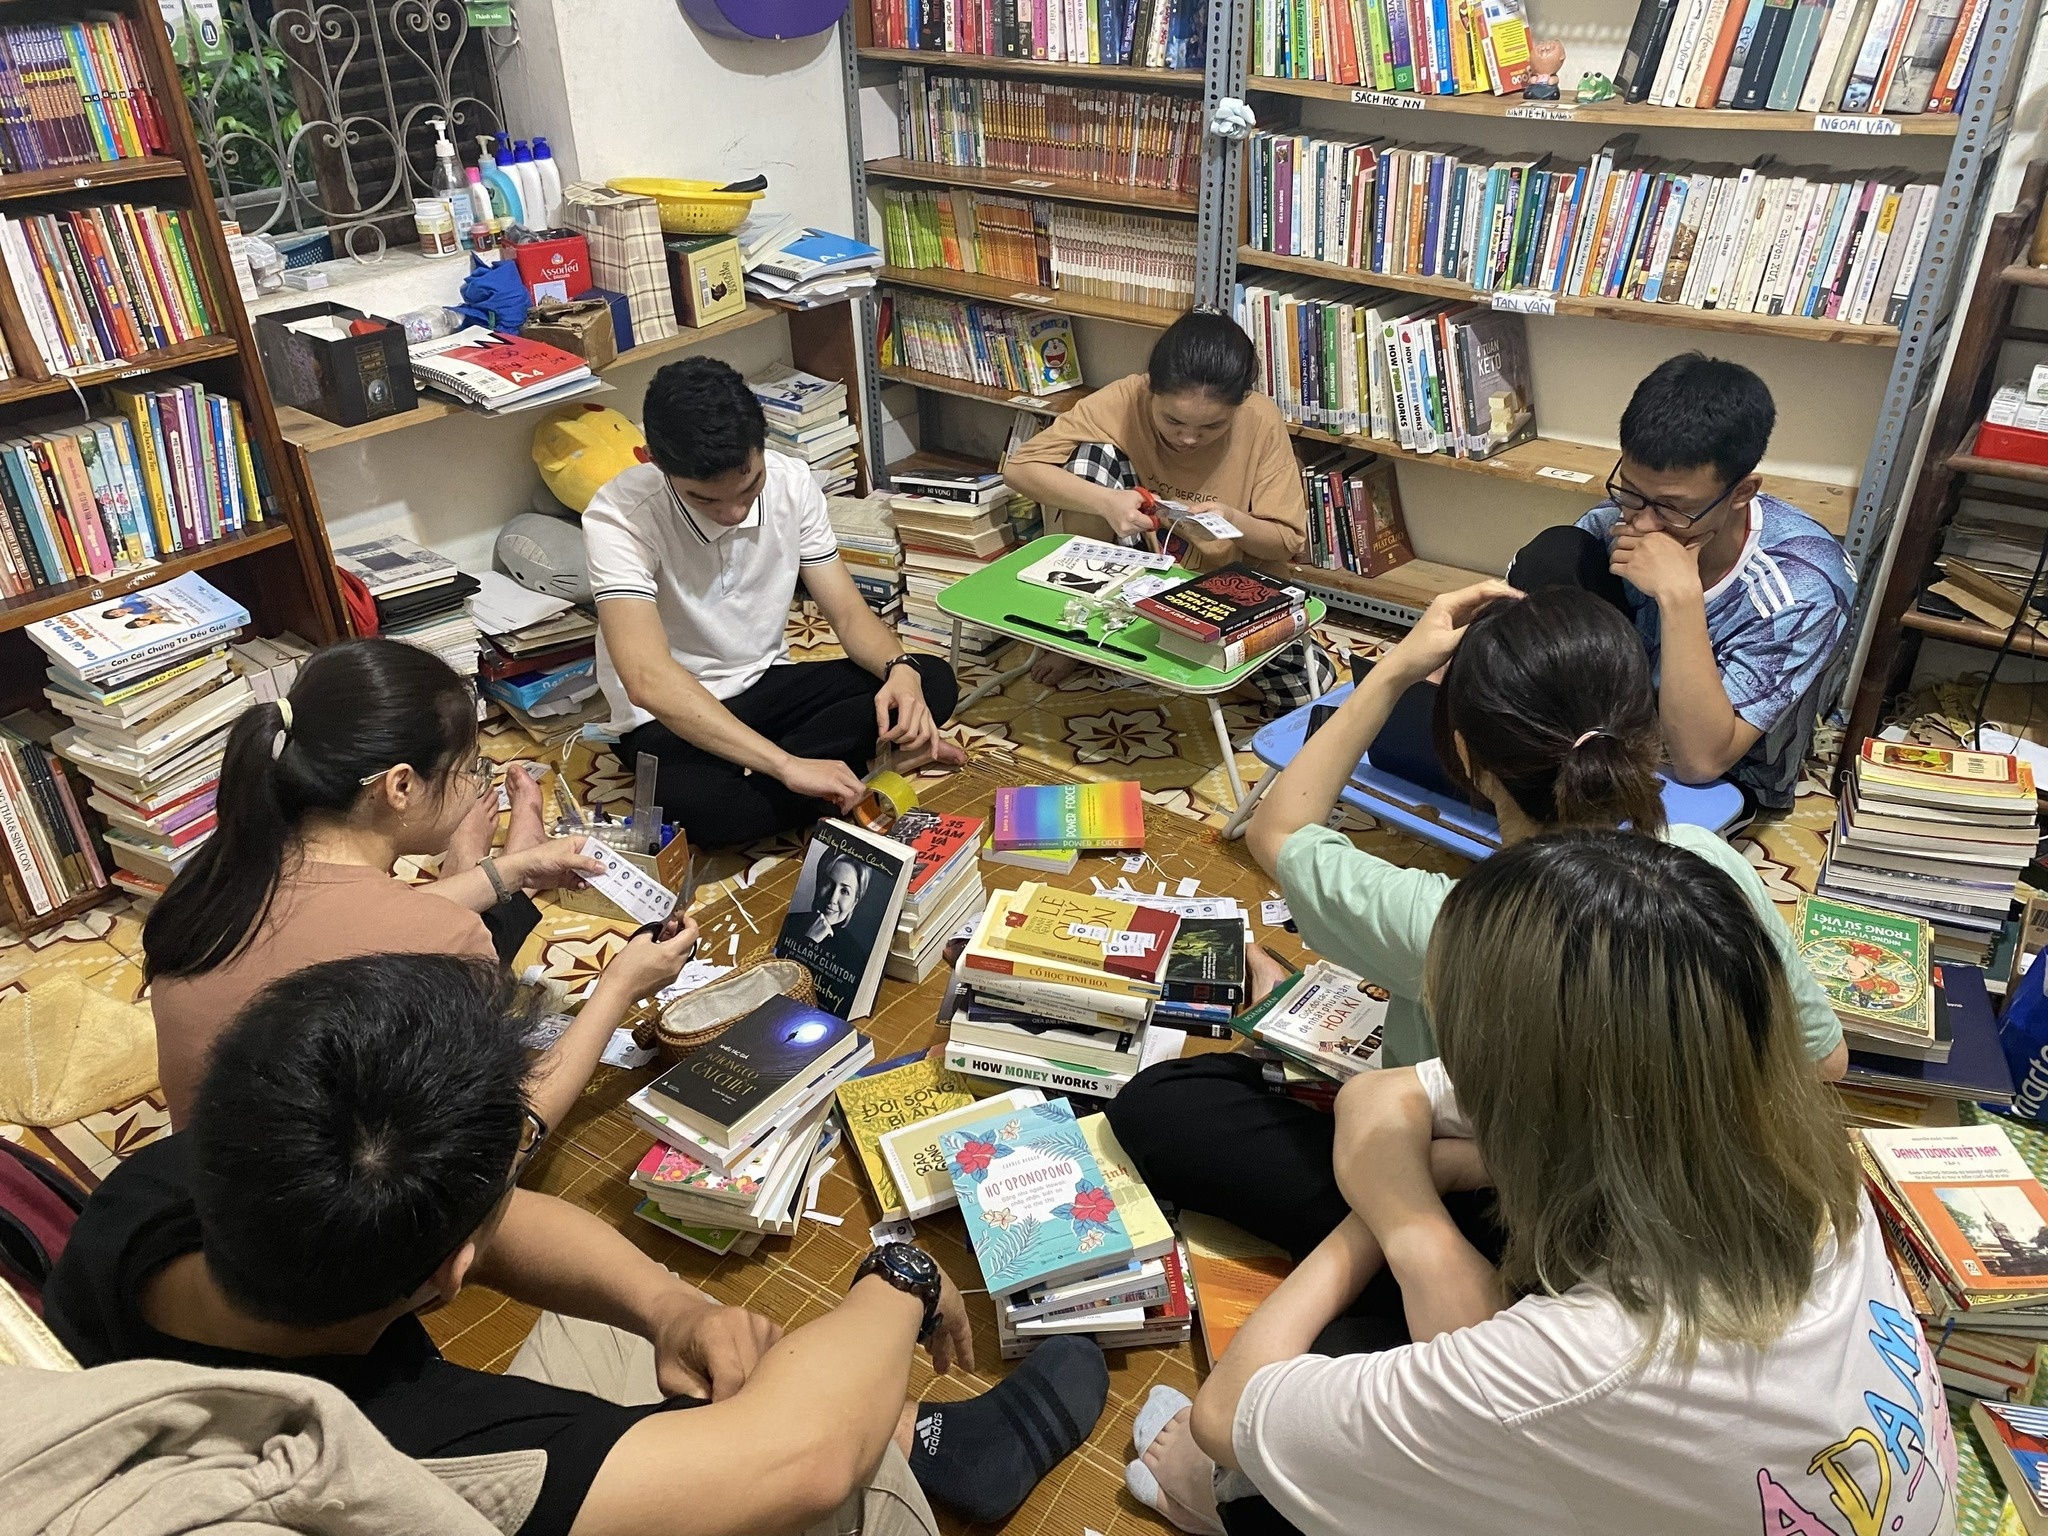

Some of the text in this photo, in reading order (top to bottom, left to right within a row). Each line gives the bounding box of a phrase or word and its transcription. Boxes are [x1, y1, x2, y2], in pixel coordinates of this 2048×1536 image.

[1675, 39, 1693, 70] Oxford
[1355, 91, 1380, 103] SÁCH
[1382, 95, 1398, 107] HỌC
[540, 258, 579, 279] Assorted
[820, 252, 847, 263] A4
[184, 262, 194, 278] NGON
[1405, 346, 1413, 365] HOW
[1477, 346, 1481, 358] 4
[1478, 353, 1502, 376] KETO
[511, 369, 544, 383] A4
[1388, 344, 1408, 427] HOW FOOD WORKS
[1410, 375, 1419, 403] BODY
[1413, 403, 1422, 431] WORKS
[174, 455, 182, 469] CON
[927, 487, 951, 497] HI VỌNG
[1148, 475, 1218, 503] JUCY BERRIES
[175, 541, 182, 549] 2
[1164, 594, 1225, 621] ĐẤT NƯỚC
[1176, 592, 1230, 617] VIỆT NAM
[1201, 596, 1219, 606] CÁC
[1219, 603, 1237, 612] QUA
[1155, 604, 1201, 625] ĐÀO DUY ANH
[1237, 632, 1248, 640] CON
[1248, 623, 1264, 634] HỒNG
[1264, 616, 1279, 628] CHÂU
[1278, 610, 1289, 620] LẠC
[52, 627, 75, 643] Chúng
[111, 623, 227, 667] Con Cái Chúng Ta Đều Giỏi
[70, 641, 86, 653] Cái
[83, 650, 98, 660] Con
[147, 675, 166, 688] ĐẢO
[167, 665, 188, 680] CHÌM
[1065, 785, 1075, 838] POWER FORCE
[929, 827, 965, 839] NĂM
[945, 820, 965, 829] 35
[930, 835, 948, 846] VÀ
[1063, 838, 1124, 848] POWER FORCE
[11, 831, 23, 853] SINH
[17, 850, 33, 873] CON
[817, 829, 894, 876] Hillary Rodham Clinton
[1036, 895, 1065, 918] LÊ
[1052, 900, 1089, 942] QUÝ
[1811, 912, 1912, 942] TRONG SỬ VIỆT
[1840, 929, 1858, 937] VUA
[1870, 935, 1902, 946] NHỮNG
[784, 937, 819, 962] HILLARY
[819, 955, 856, 985] CLINTON
[1029, 966, 1109, 988] CỔ HỌC TINH HOA
[1308, 1011, 1326, 1026] nhất
[1322, 998, 1337, 1014] phu
[1335, 984, 1352, 1000] nhân
[1320, 1009, 1351, 1032] HOA
[973, 1060, 1099, 1091] HOW MONEY WORKS
[862, 1081, 955, 1122] ĐỜI SỐNG
[887, 1101, 938, 1127] BÍ ẨN
[1892, 1144, 2001, 1161] DANH TƯỚNG VIỆT NAM
[914, 1152, 934, 1177] BÃO
[1002, 1193, 1016, 1202] Sống
[1018, 1188, 1029, 1196] như
[1030, 1184, 1044, 1195] người
[1011, 1199, 1024, 1208] chấp
[1042, 1189, 1054, 1198] biết
[1033, 1198, 1044, 1207] tha
[1045, 1195, 1055, 1204] thứ
[1902, 1241, 1929, 1291] TRANH
[928, 1411, 943, 1456] adidas
